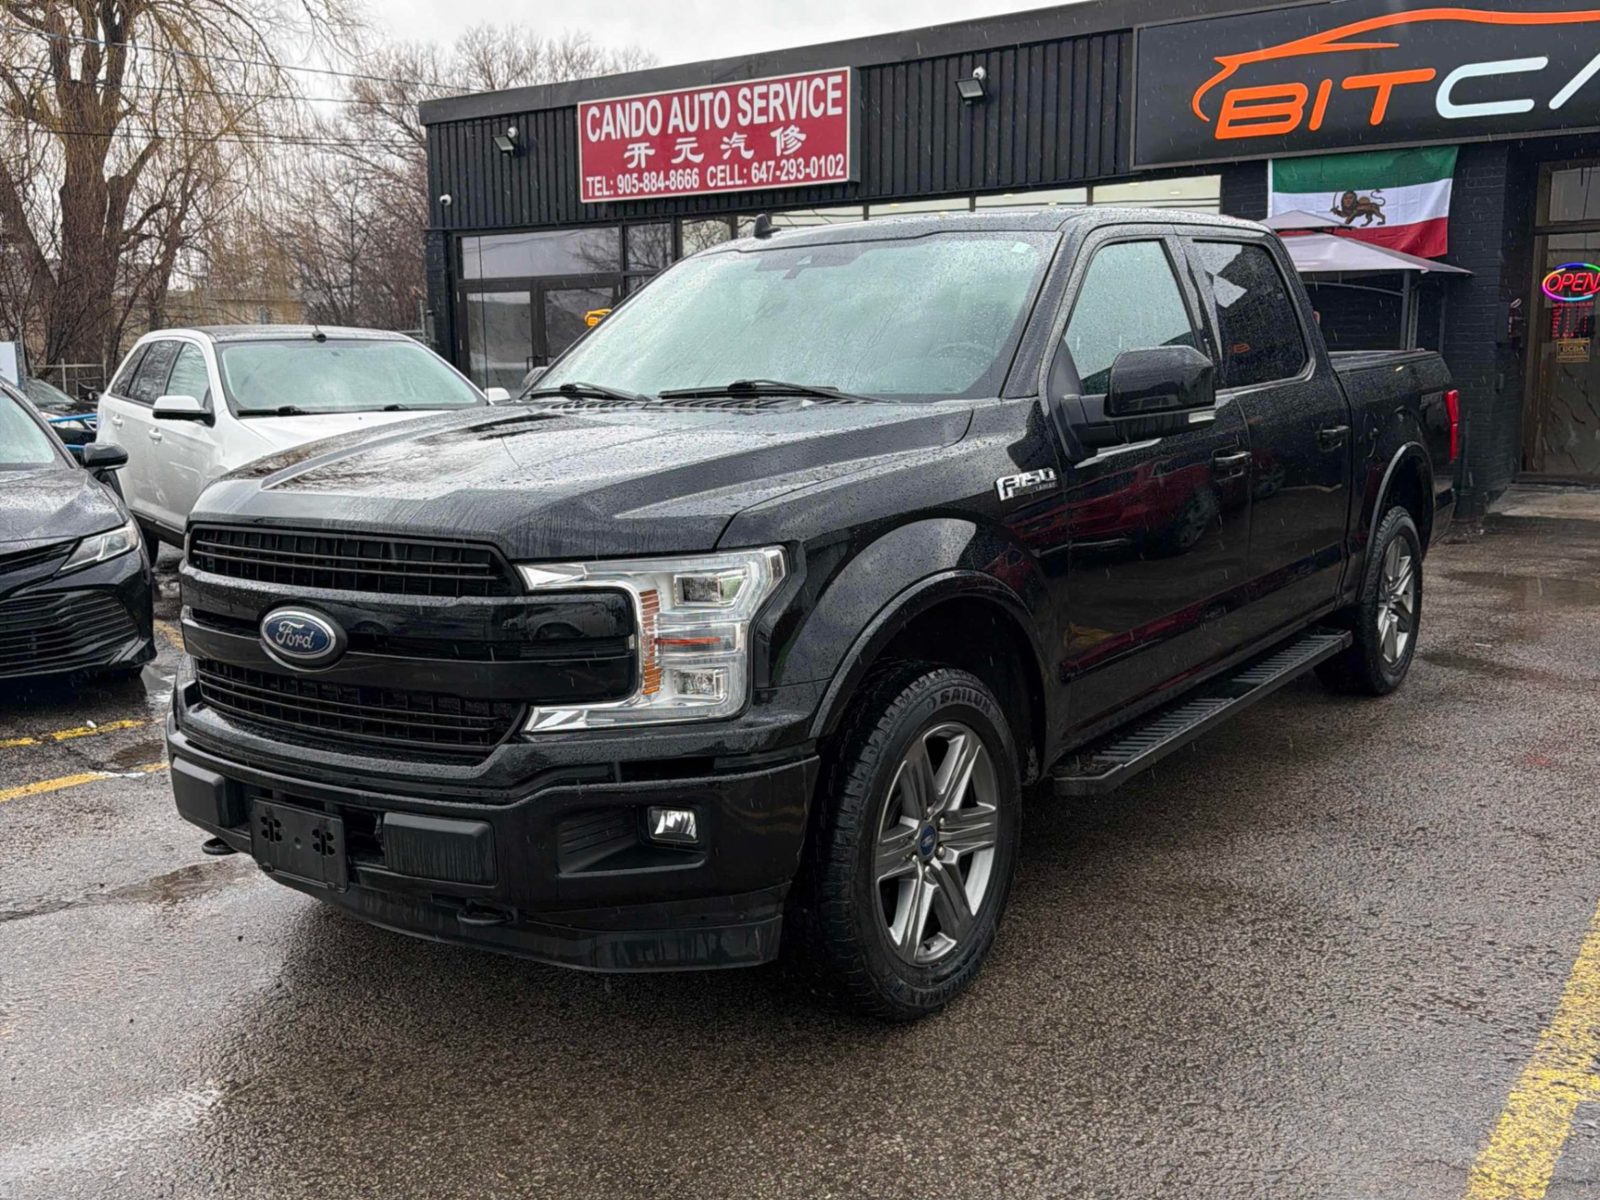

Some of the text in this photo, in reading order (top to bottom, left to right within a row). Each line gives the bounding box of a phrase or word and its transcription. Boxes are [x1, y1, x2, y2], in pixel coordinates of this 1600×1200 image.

[586, 75, 843, 142] CANDO AUTO SERVICE
[623, 124, 807, 169] 开元汽修
[586, 153, 844, 197] TEL: 905-884-8666 CELL: 647-293-0102
[1548, 272, 1600, 292] OPEN
[275, 620, 315, 649] Ford
